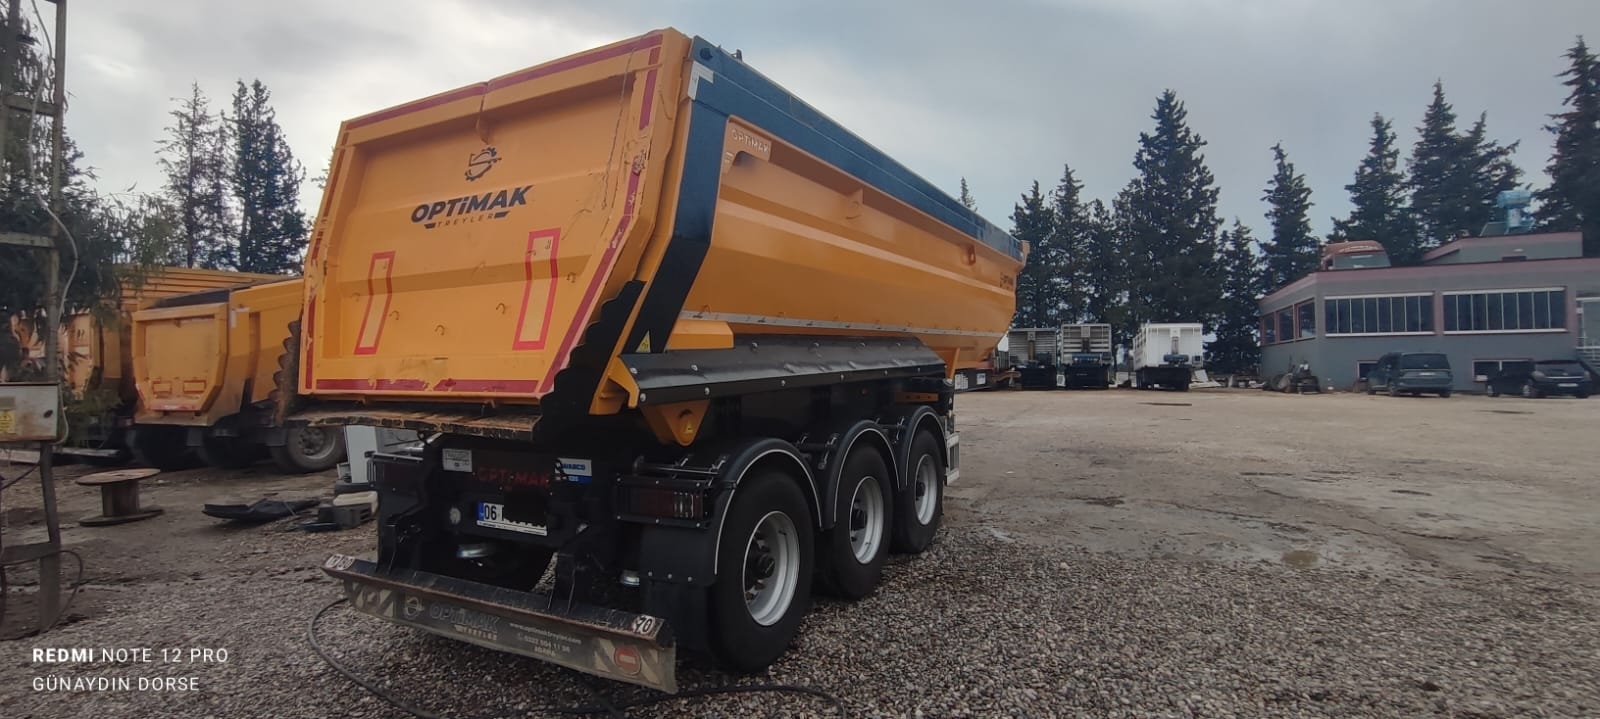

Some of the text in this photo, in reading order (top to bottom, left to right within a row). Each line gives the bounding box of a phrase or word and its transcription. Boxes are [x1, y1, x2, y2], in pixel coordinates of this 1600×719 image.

[437, 212, 494, 228] TREYLER
[484, 504, 497, 520] 06
[635, 616, 653, 633] 70
